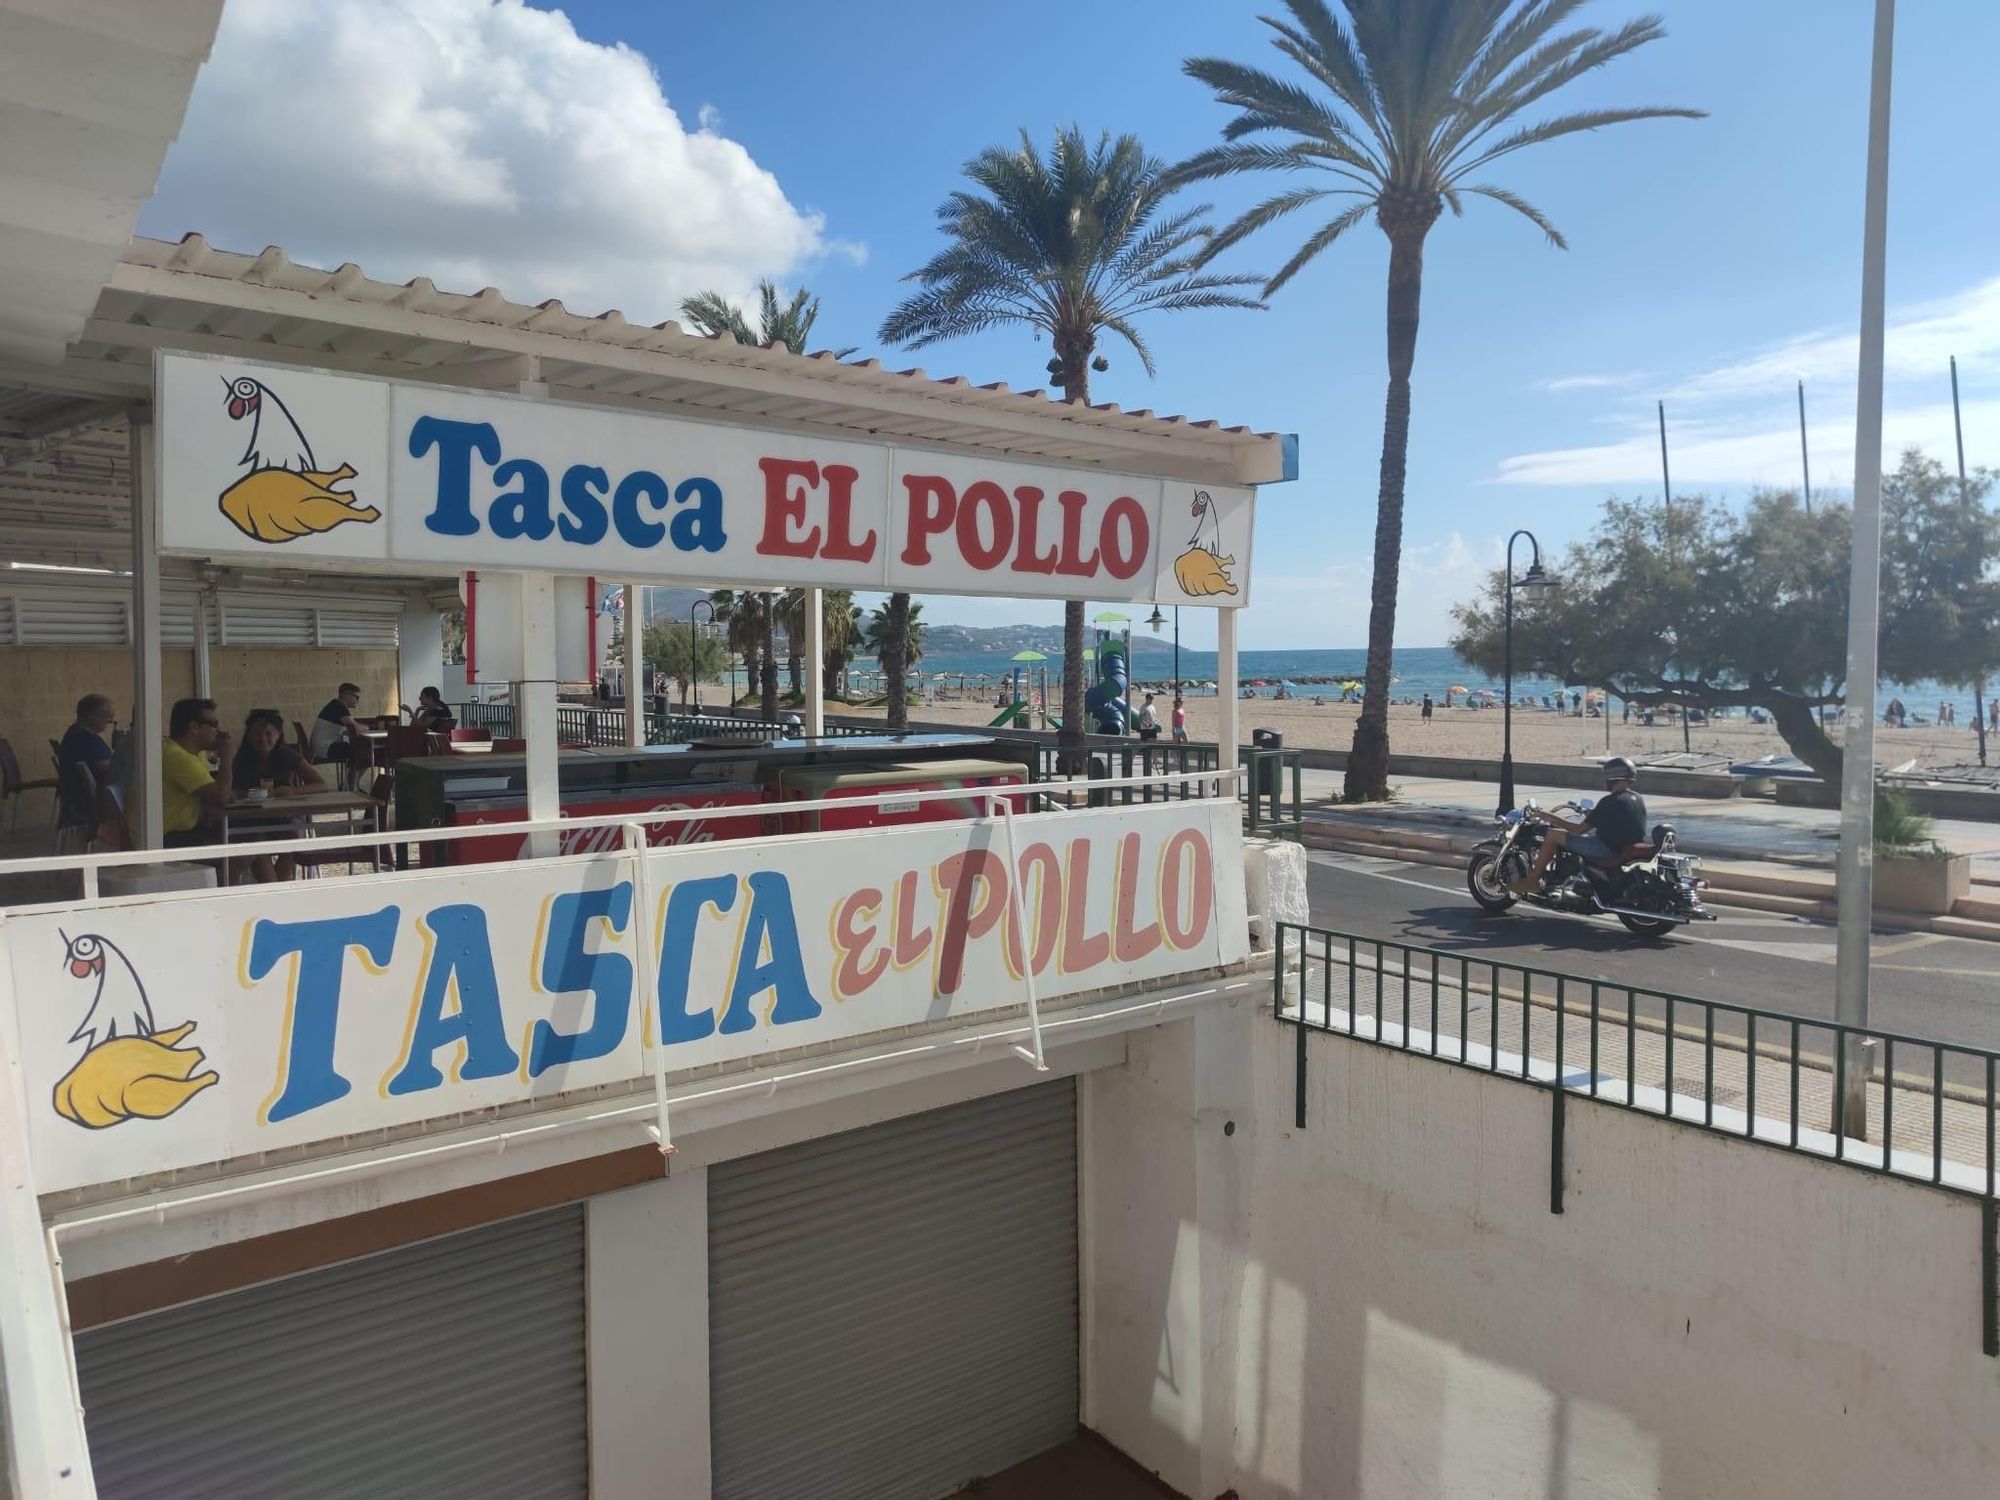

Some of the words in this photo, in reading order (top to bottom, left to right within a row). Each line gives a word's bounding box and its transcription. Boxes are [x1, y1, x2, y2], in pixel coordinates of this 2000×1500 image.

[408, 415, 728, 554] Tasca
[756, 457, 877, 564] EL
[900, 474, 1150, 580] POLLO
[516, 800, 728, 860] ocaola
[238, 871, 822, 1127] TASCA
[829, 871, 932, 1002] EL
[932, 827, 1213, 999] POLLO
